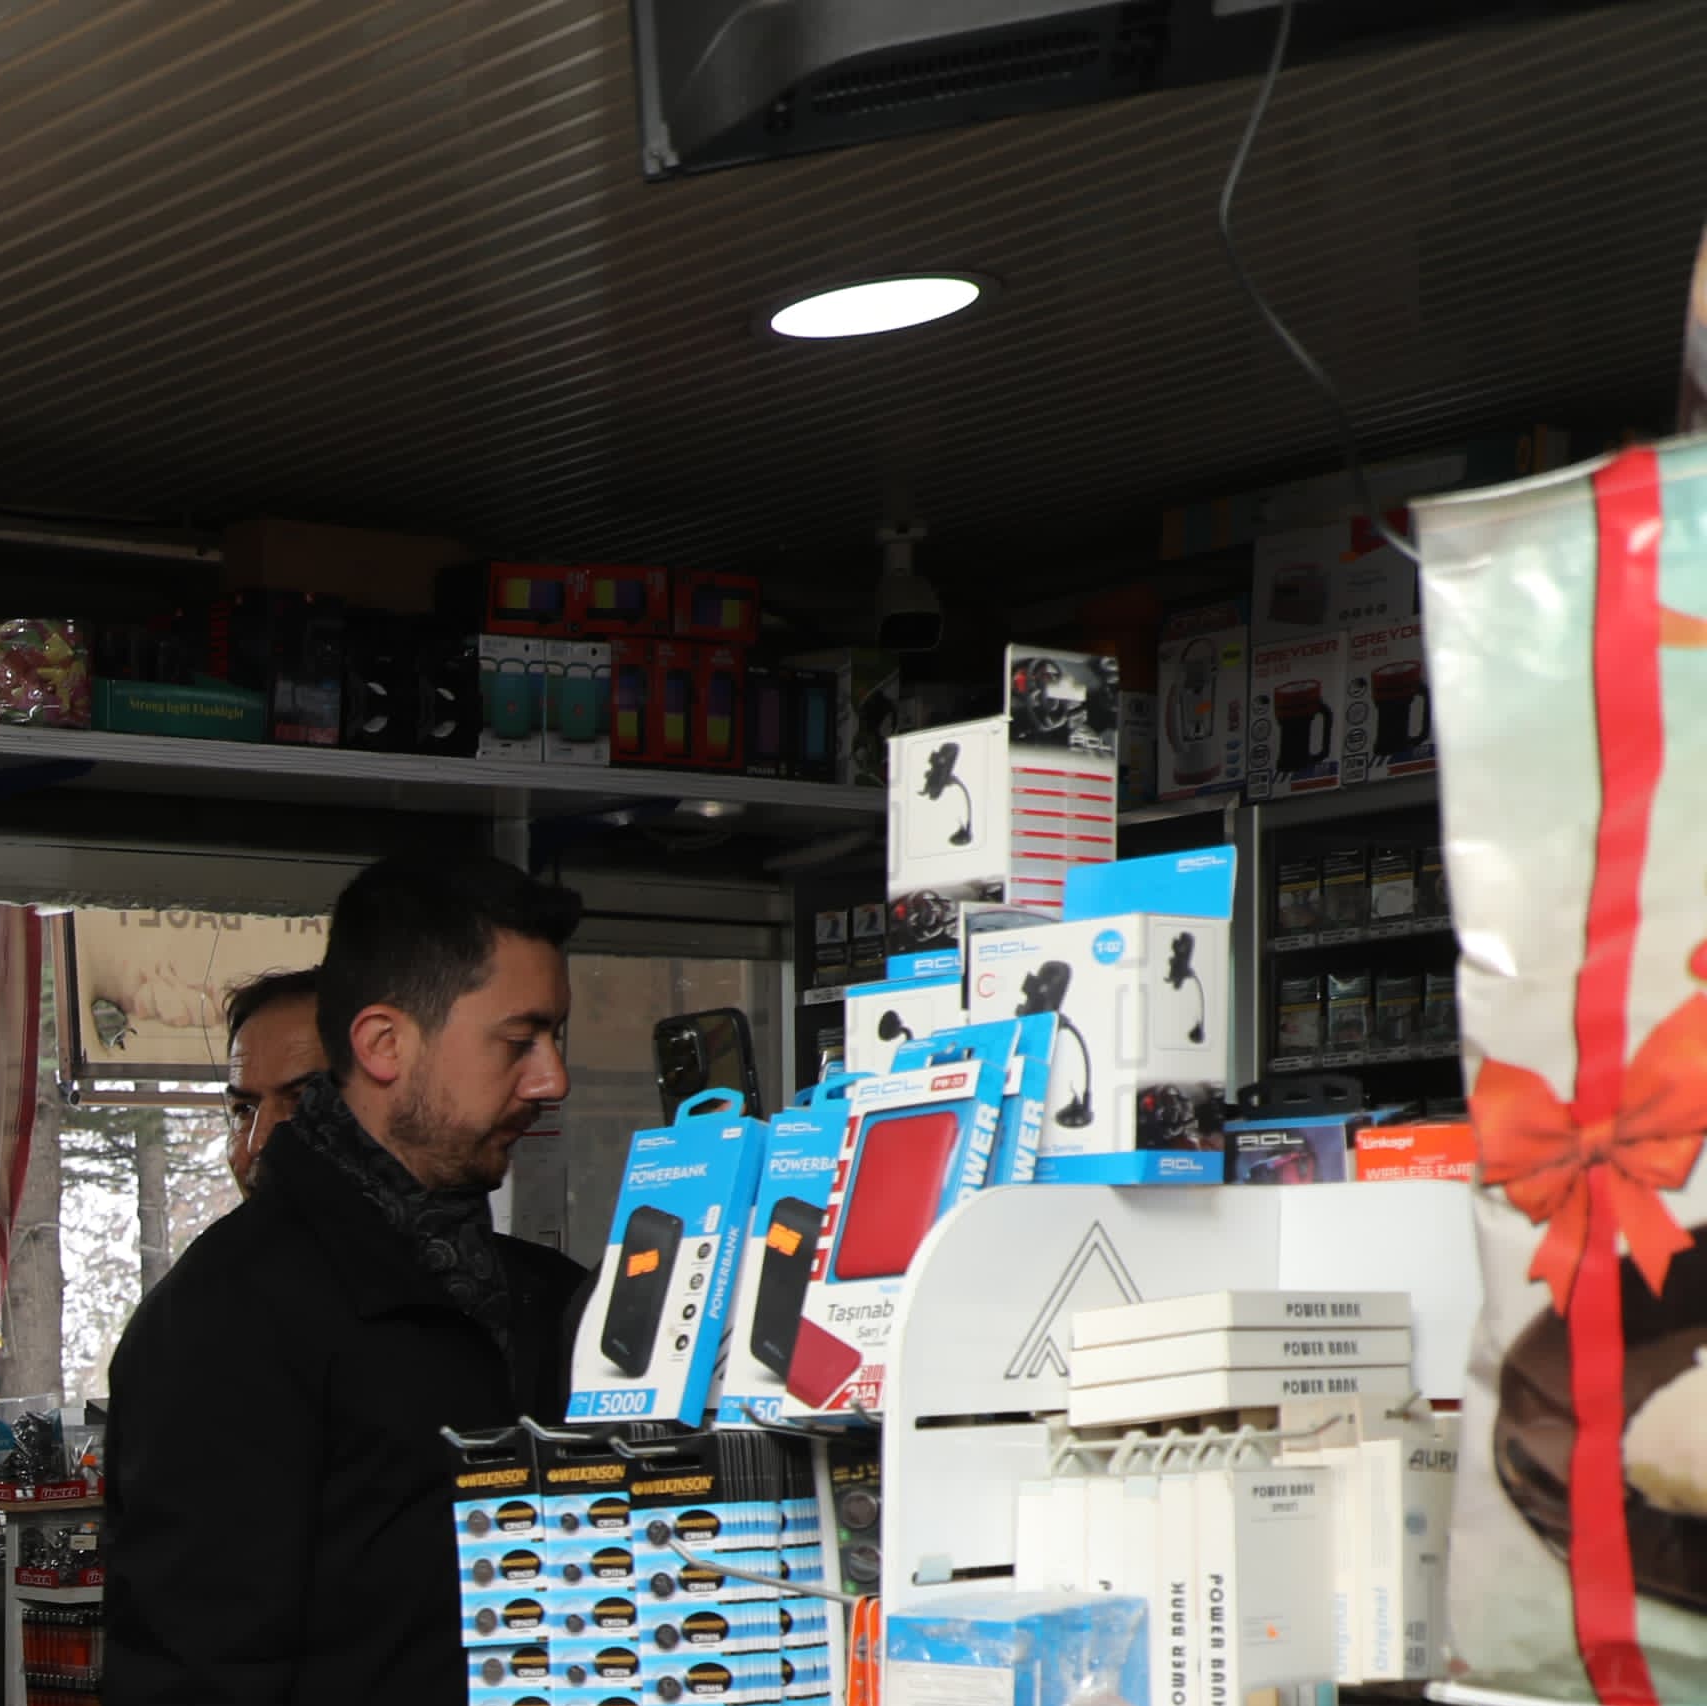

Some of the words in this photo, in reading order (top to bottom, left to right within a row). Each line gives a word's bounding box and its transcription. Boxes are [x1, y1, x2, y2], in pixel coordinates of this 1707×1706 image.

[628, 1163, 708, 1184] POWERBANK
[709, 1225, 740, 1320] POWERBANK
[1286, 1303, 1323, 1319] POWER
[596, 1392, 647, 1414] 5000
[470, 1468, 529, 1488] WILKINSON
[560, 1464, 627, 1483] WILKINSON
[643, 1475, 713, 1495] WILKINSON
[1171, 1582, 1186, 1635] BANK
[1209, 1573, 1225, 1649] POWER
